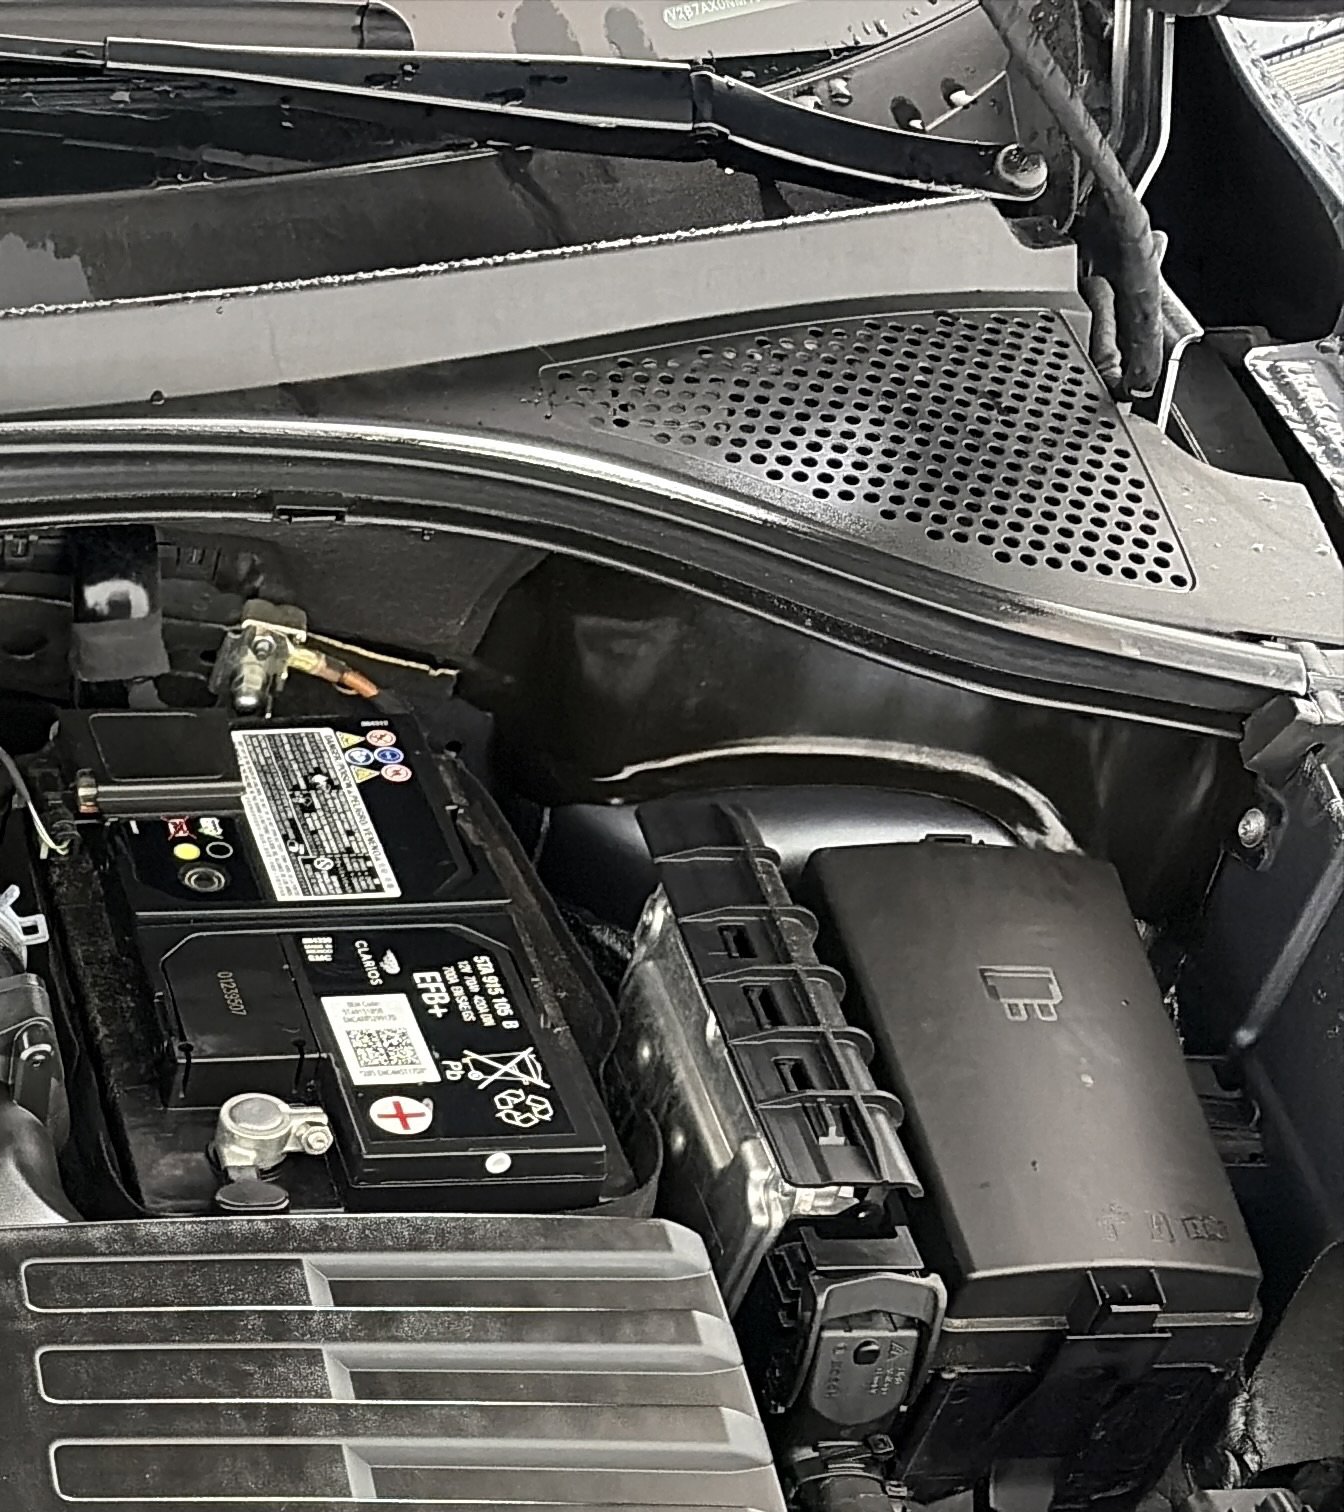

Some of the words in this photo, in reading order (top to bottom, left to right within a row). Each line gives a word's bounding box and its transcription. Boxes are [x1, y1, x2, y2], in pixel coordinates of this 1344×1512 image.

[354, 940, 383, 986] CLARIOS
[216, 970, 249, 1017] 01239507
[413, 972, 450, 1018] EFB+
[442, 1060, 465, 1081] Pb
